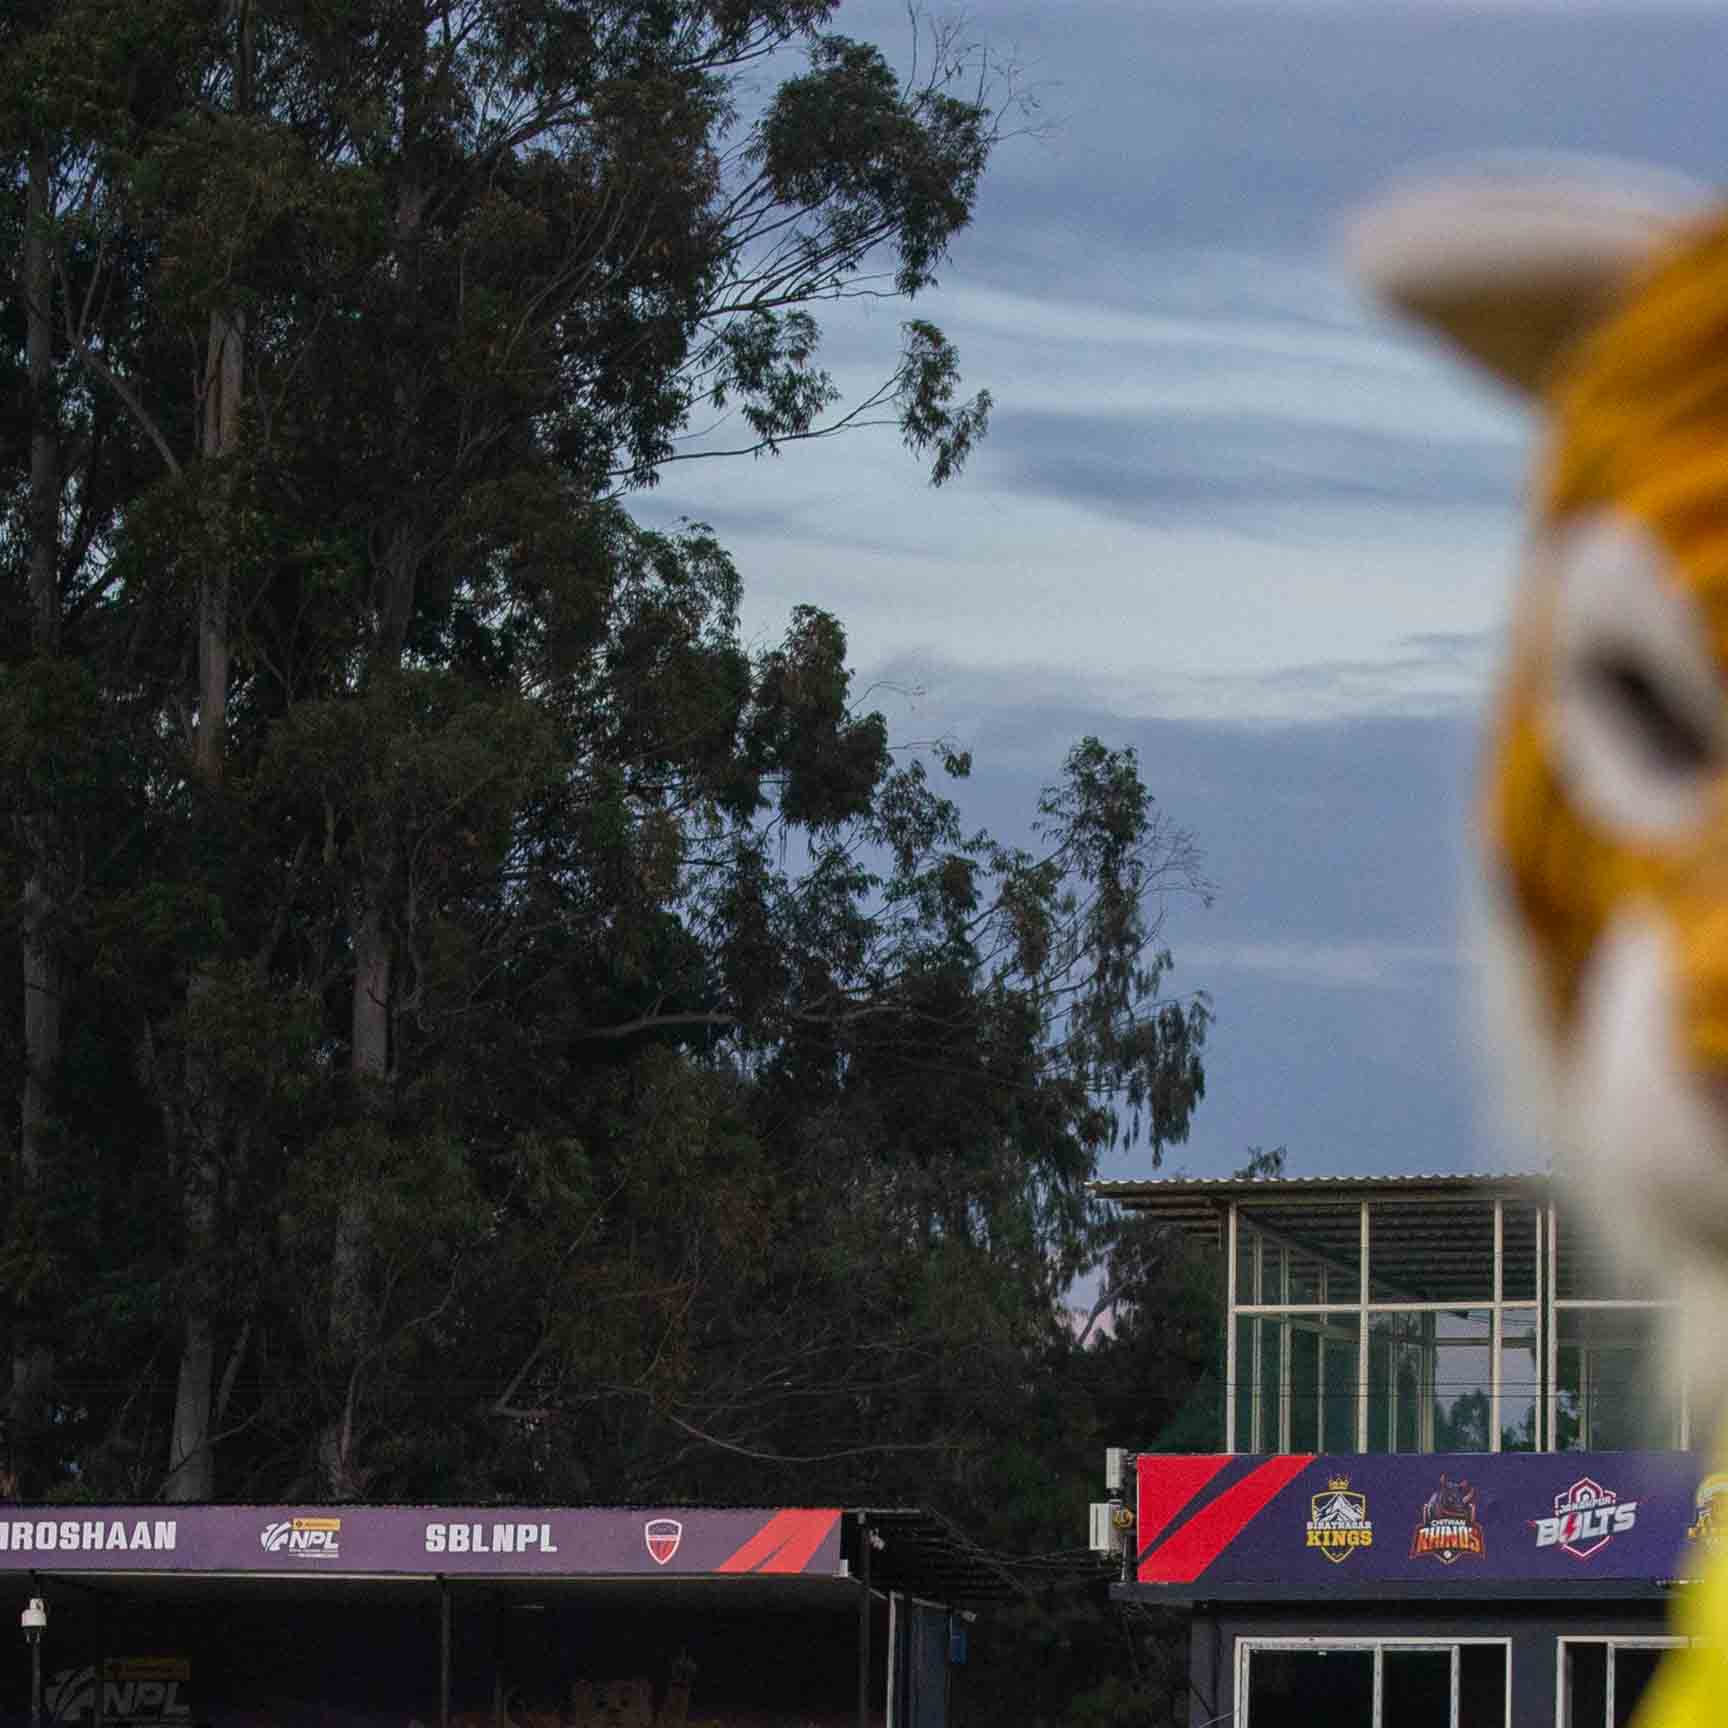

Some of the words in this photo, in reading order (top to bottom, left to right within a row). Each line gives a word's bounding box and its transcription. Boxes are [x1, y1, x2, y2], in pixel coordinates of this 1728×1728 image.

[425, 1523, 558, 1554] SBLNPL
[1535, 1501, 1639, 1548] BOLTS
[289, 1531, 340, 1551] NPL
[1306, 1530, 1374, 1548] KINGS
[1416, 1526, 1484, 1554] RHINOS
